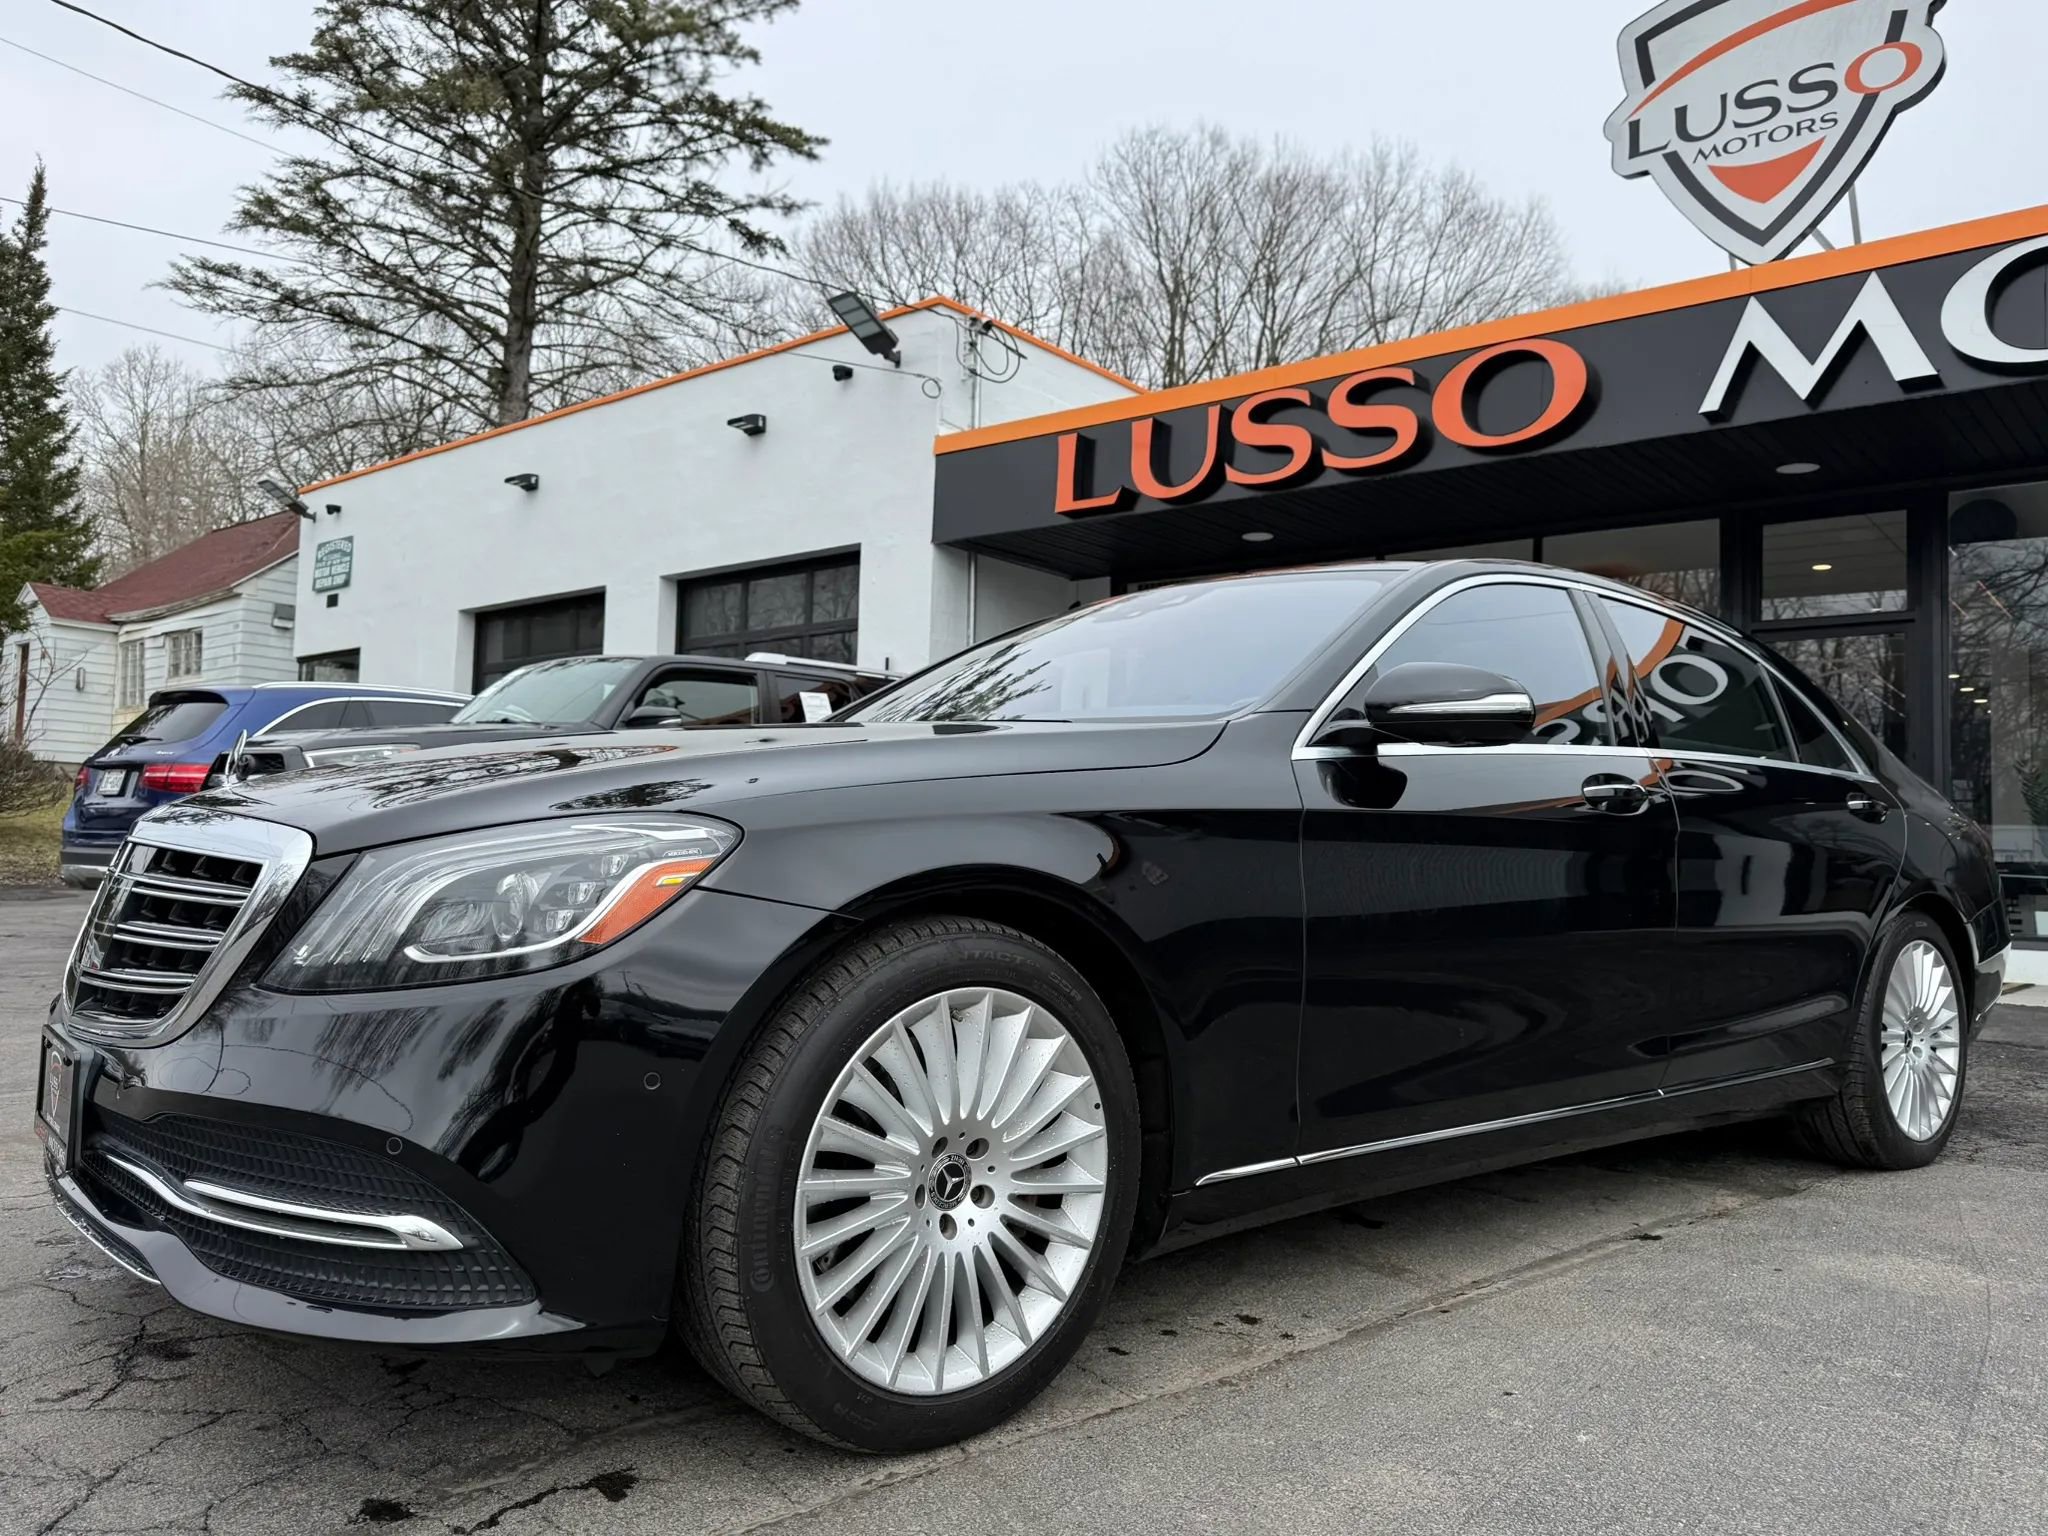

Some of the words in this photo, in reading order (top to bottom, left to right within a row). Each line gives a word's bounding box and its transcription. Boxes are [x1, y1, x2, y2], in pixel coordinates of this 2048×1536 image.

[1628, 41, 1923, 160] LUSSO
[1692, 111, 1839, 164] MOTORS
[1054, 338, 1588, 513] LUSSO
